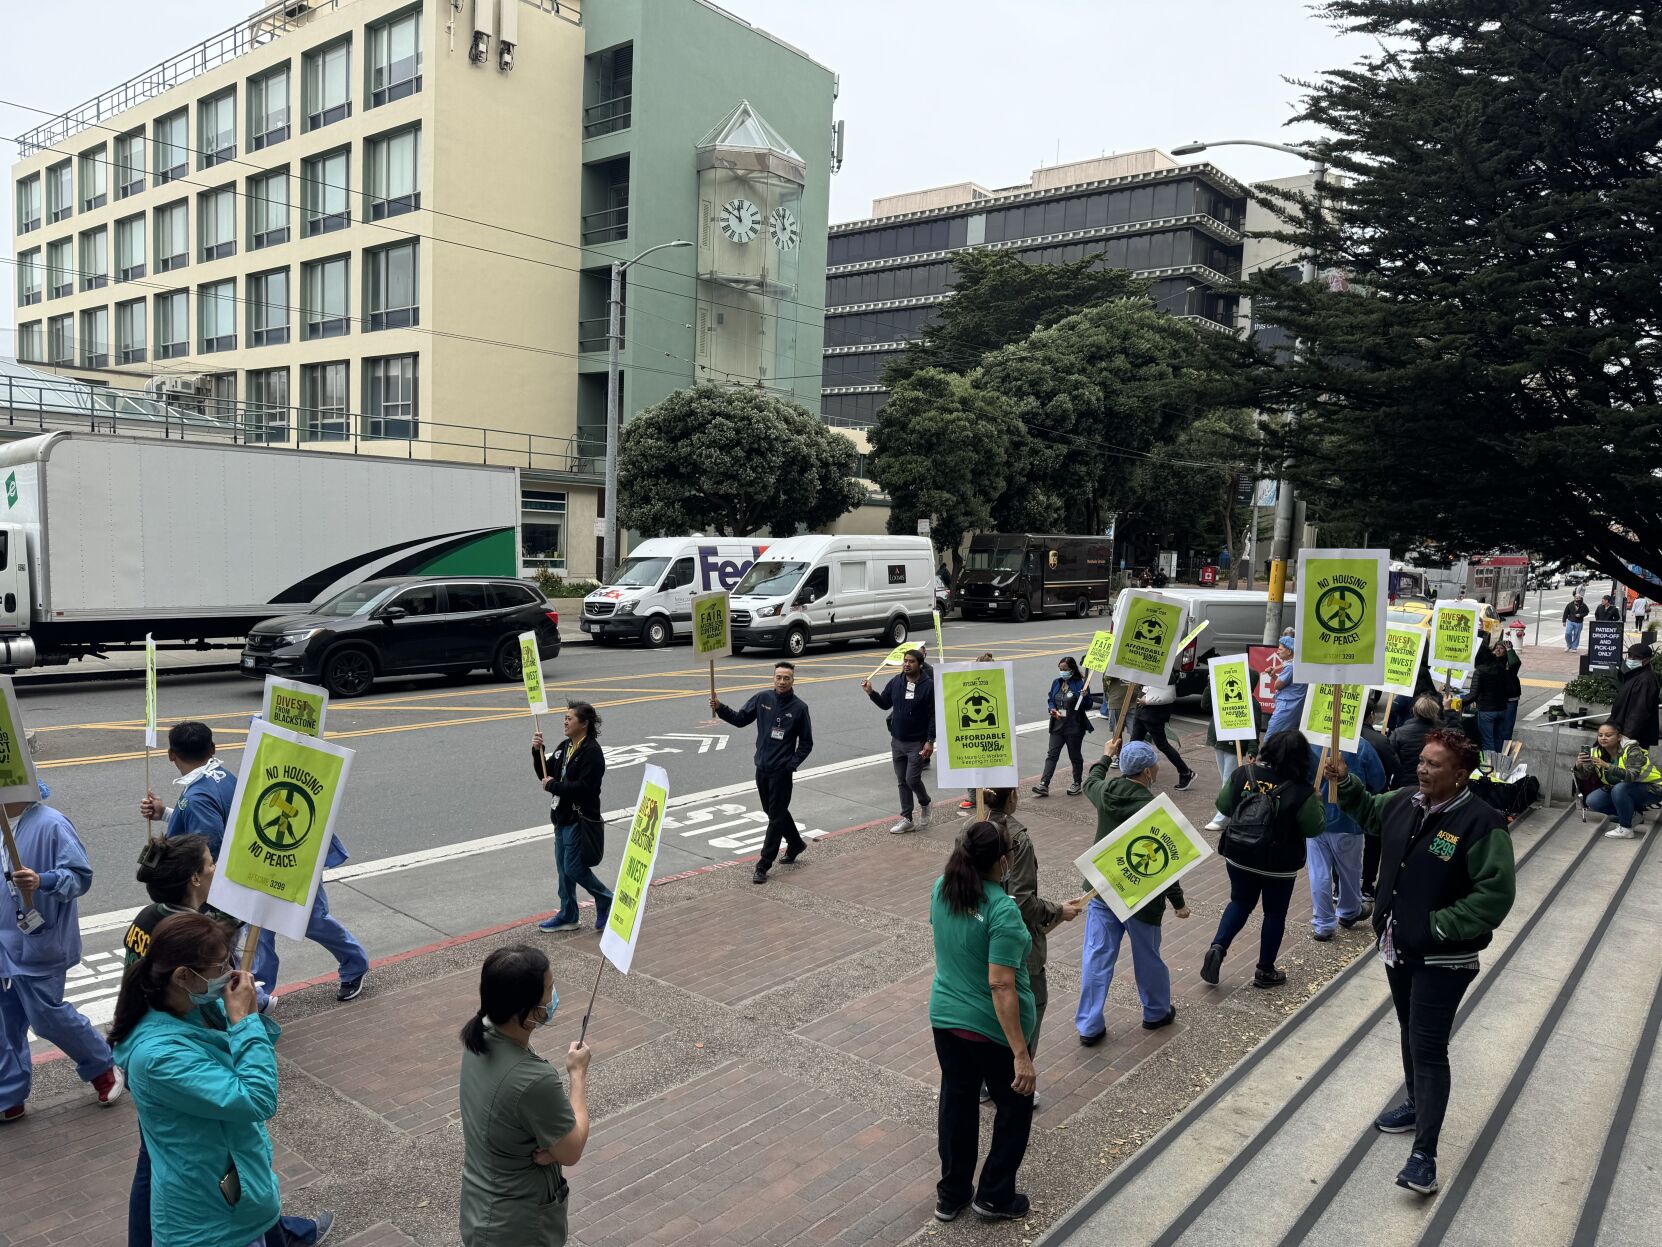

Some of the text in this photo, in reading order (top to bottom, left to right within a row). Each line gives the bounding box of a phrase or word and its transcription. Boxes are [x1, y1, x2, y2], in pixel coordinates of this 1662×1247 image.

[1317, 575, 1367, 590] NO HOUSING
[701, 610, 722, 623] FAIR
[1440, 625, 1470, 633] BLACKSTONE
[1095, 640, 1111, 650] FAIR
[1319, 632, 1360, 645] NO PEACE!
[1447, 635, 1470, 644] INVEST
[1125, 643, 1164, 656] AFFORDABLE
[1385, 646, 1416, 656] BLACKSTONE
[1390, 656, 1413, 667] INVEST
[276, 695, 309, 711] DIVEST
[275, 706, 290, 714] FROM
[274, 712, 316, 729] BLACKSTONE
[955, 733, 1006, 742] AFFORDABLE
[962, 740, 999, 748] HOUSING
[266, 765, 324, 796] NO HOUSING
[1150, 826, 1179, 861] NO HOUSING
[1437, 830, 1460, 845] AFSCME
[1429, 838, 1456, 856] 3299
[248, 841, 298, 868] NO PEACE!
[626, 856, 647, 885] INVEST
[1116, 856, 1141, 885] NO PEACE!
[270, 880, 286, 891] 3299
[126, 924, 151, 957] AFSC
